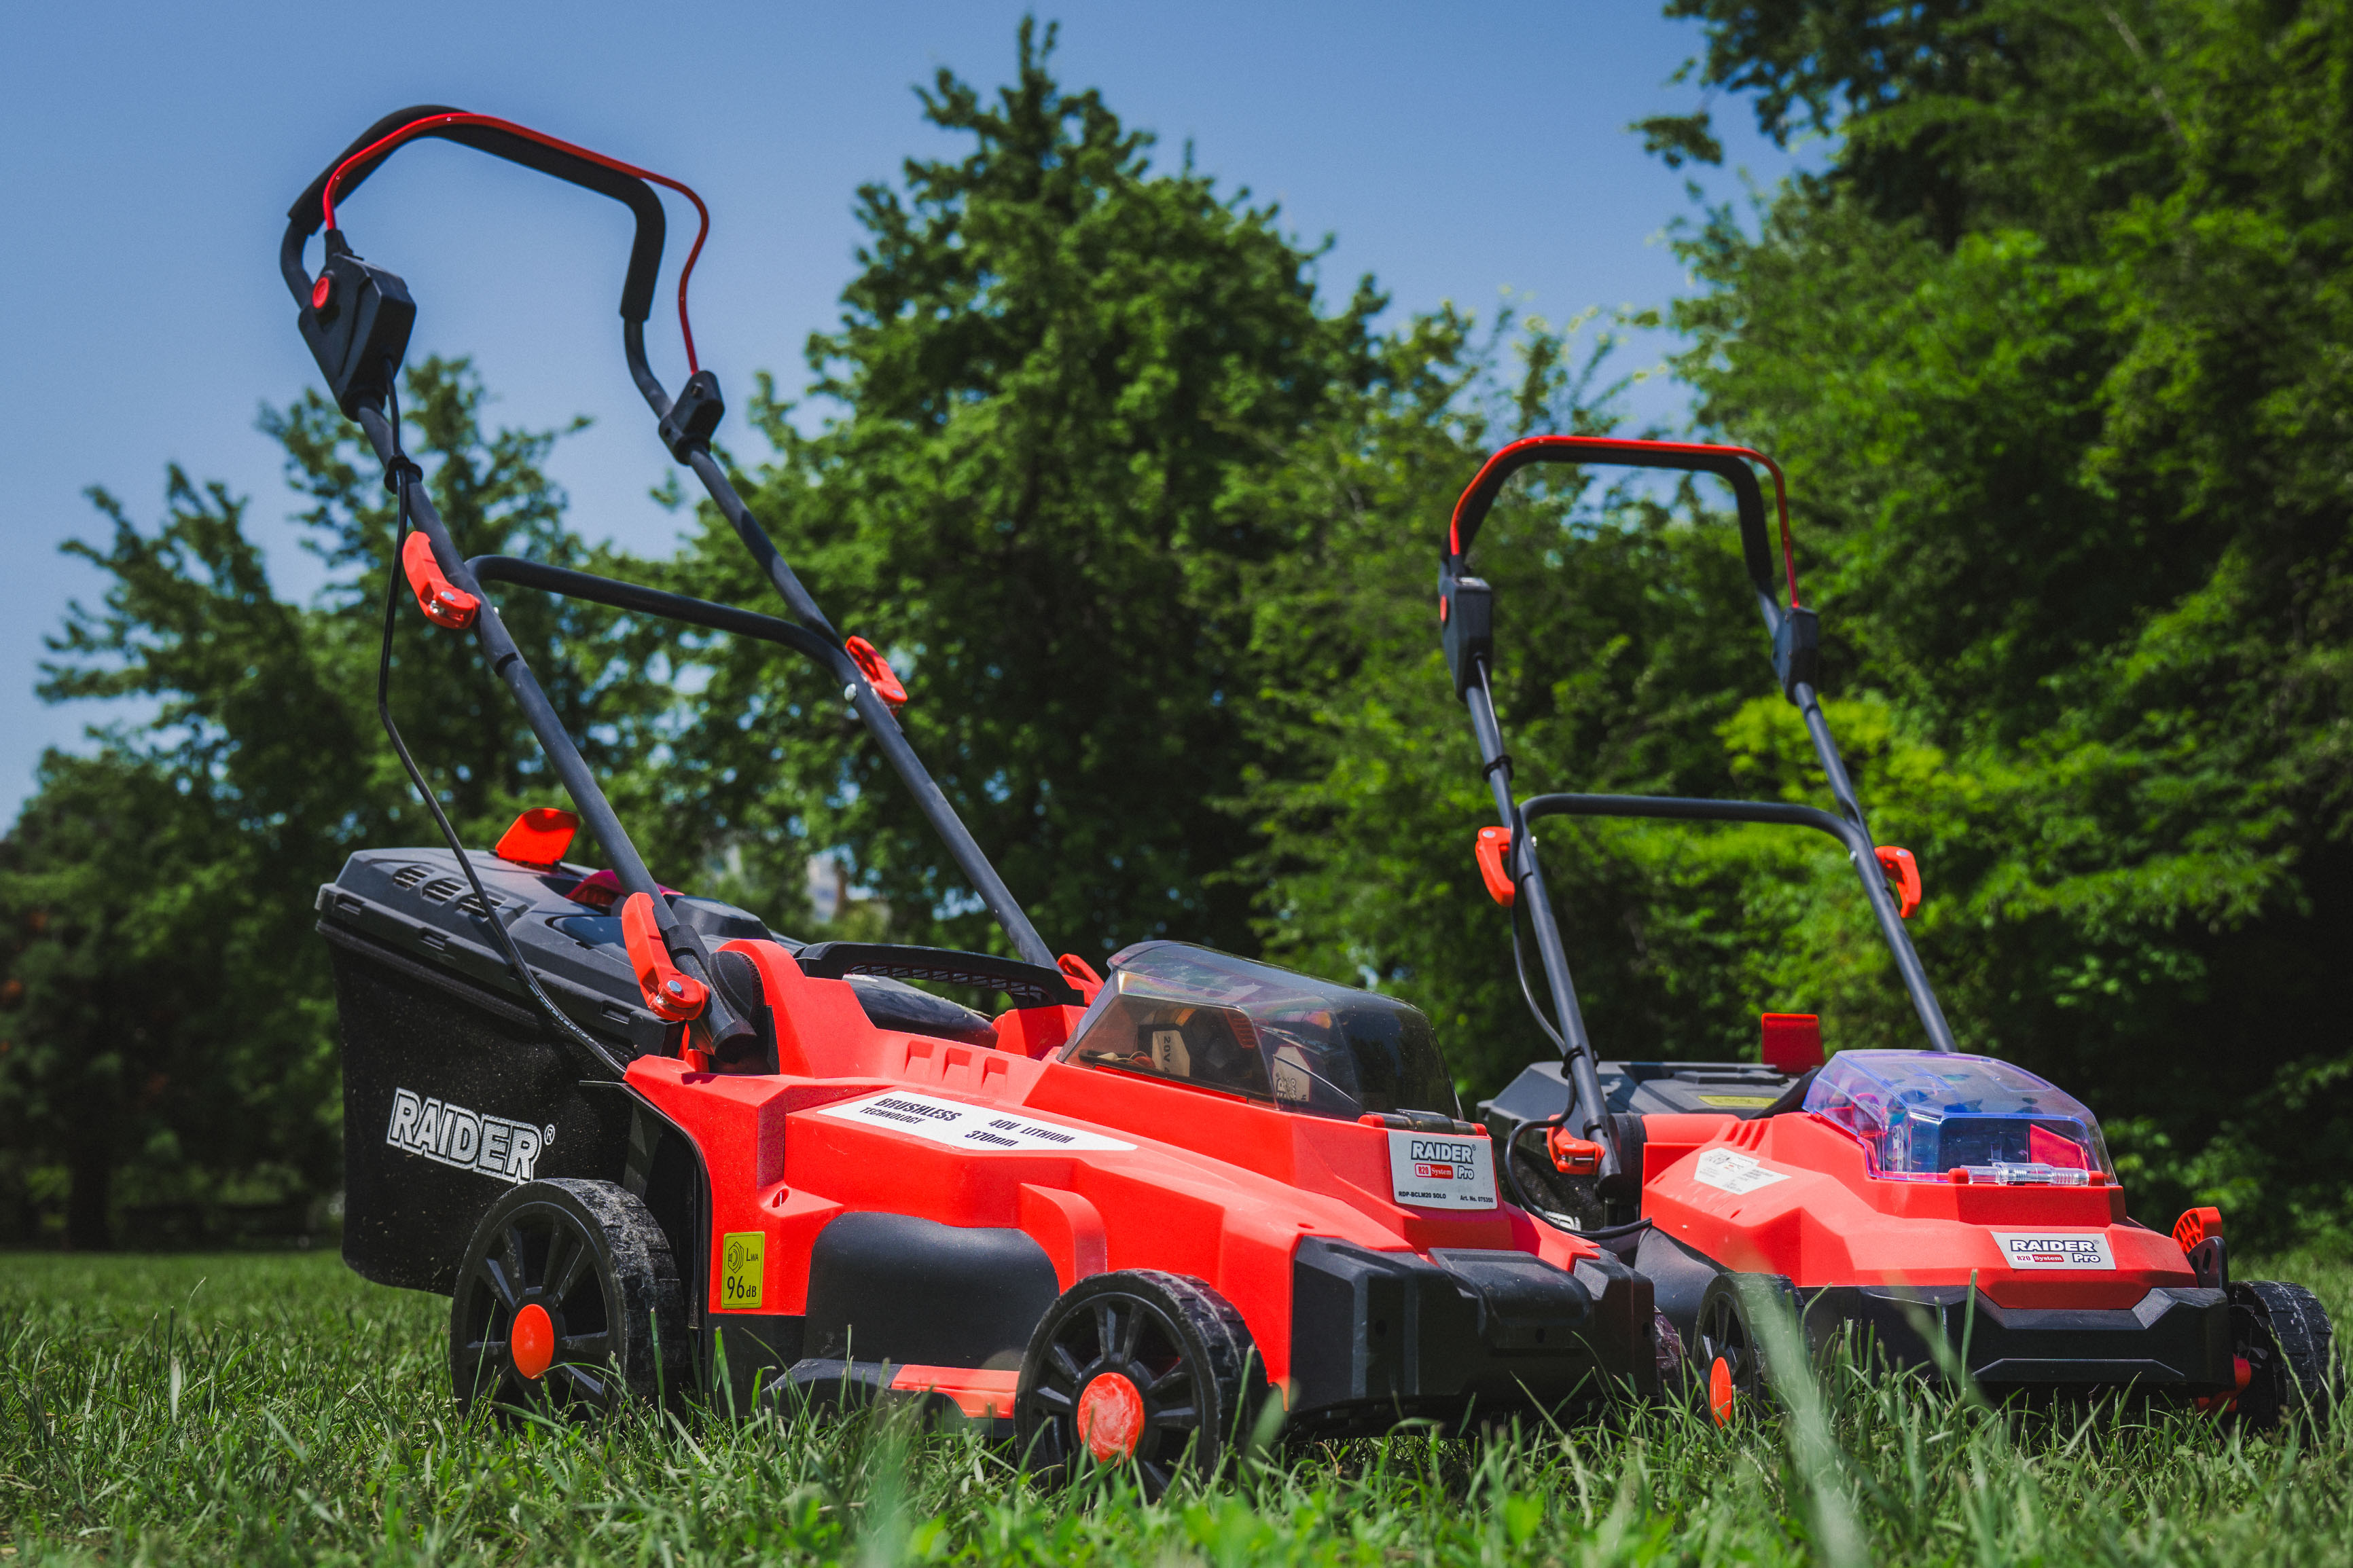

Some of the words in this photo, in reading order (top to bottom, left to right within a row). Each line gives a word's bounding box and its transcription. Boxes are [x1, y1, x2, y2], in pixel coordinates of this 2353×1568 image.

[1164, 1036, 1172, 1063] 20V
[859, 1107, 926, 1124] TECHNOLOGY
[874, 1098, 963, 1121] BRUSHLESS
[964, 1130, 1019, 1147] 370mm
[988, 1119, 1022, 1131] 40V
[1019, 1127, 1076, 1144] LITHIUM
[1418, 1166, 1429, 1174] R20
[1431, 1167, 1452, 1175] System
[1457, 1165, 1474, 1180] Pro
[2072, 1253, 2100, 1262] Pro
